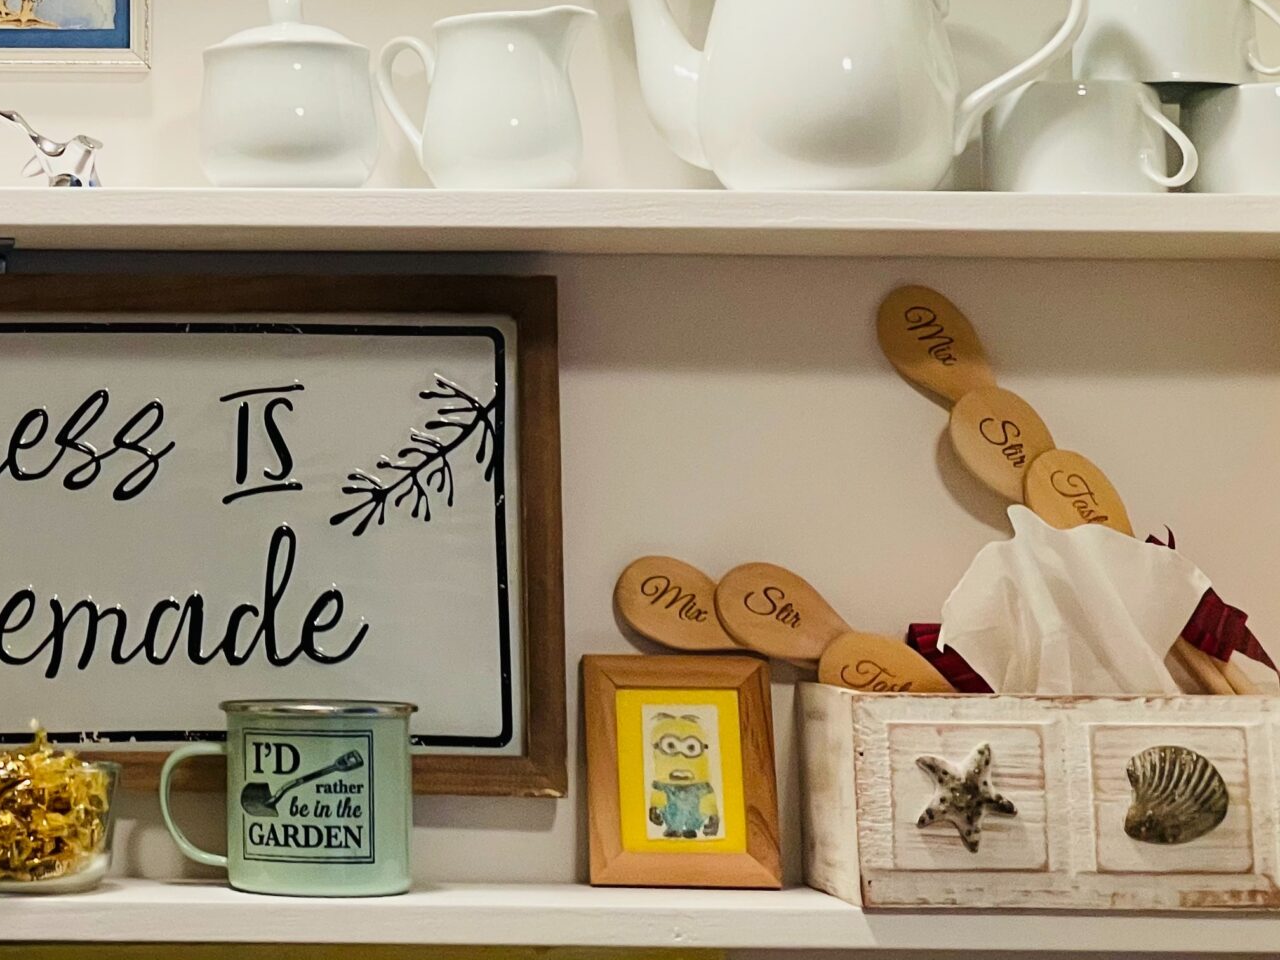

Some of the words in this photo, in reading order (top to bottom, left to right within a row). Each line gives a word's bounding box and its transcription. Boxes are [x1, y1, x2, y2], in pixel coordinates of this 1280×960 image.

[903, 305, 957, 366] Mix
[219, 381, 306, 505] IS
[979, 417, 1026, 468] Stir
[640, 575, 708, 623] Mix
[743, 586, 802, 629] Stir
[252, 742, 301, 774] I'D
[289, 795, 310, 818] be
[313, 800, 332, 818] in
[336, 797, 362, 818] the
[315, 779, 364, 794] rather
[248, 822, 364, 849] GARDEN
